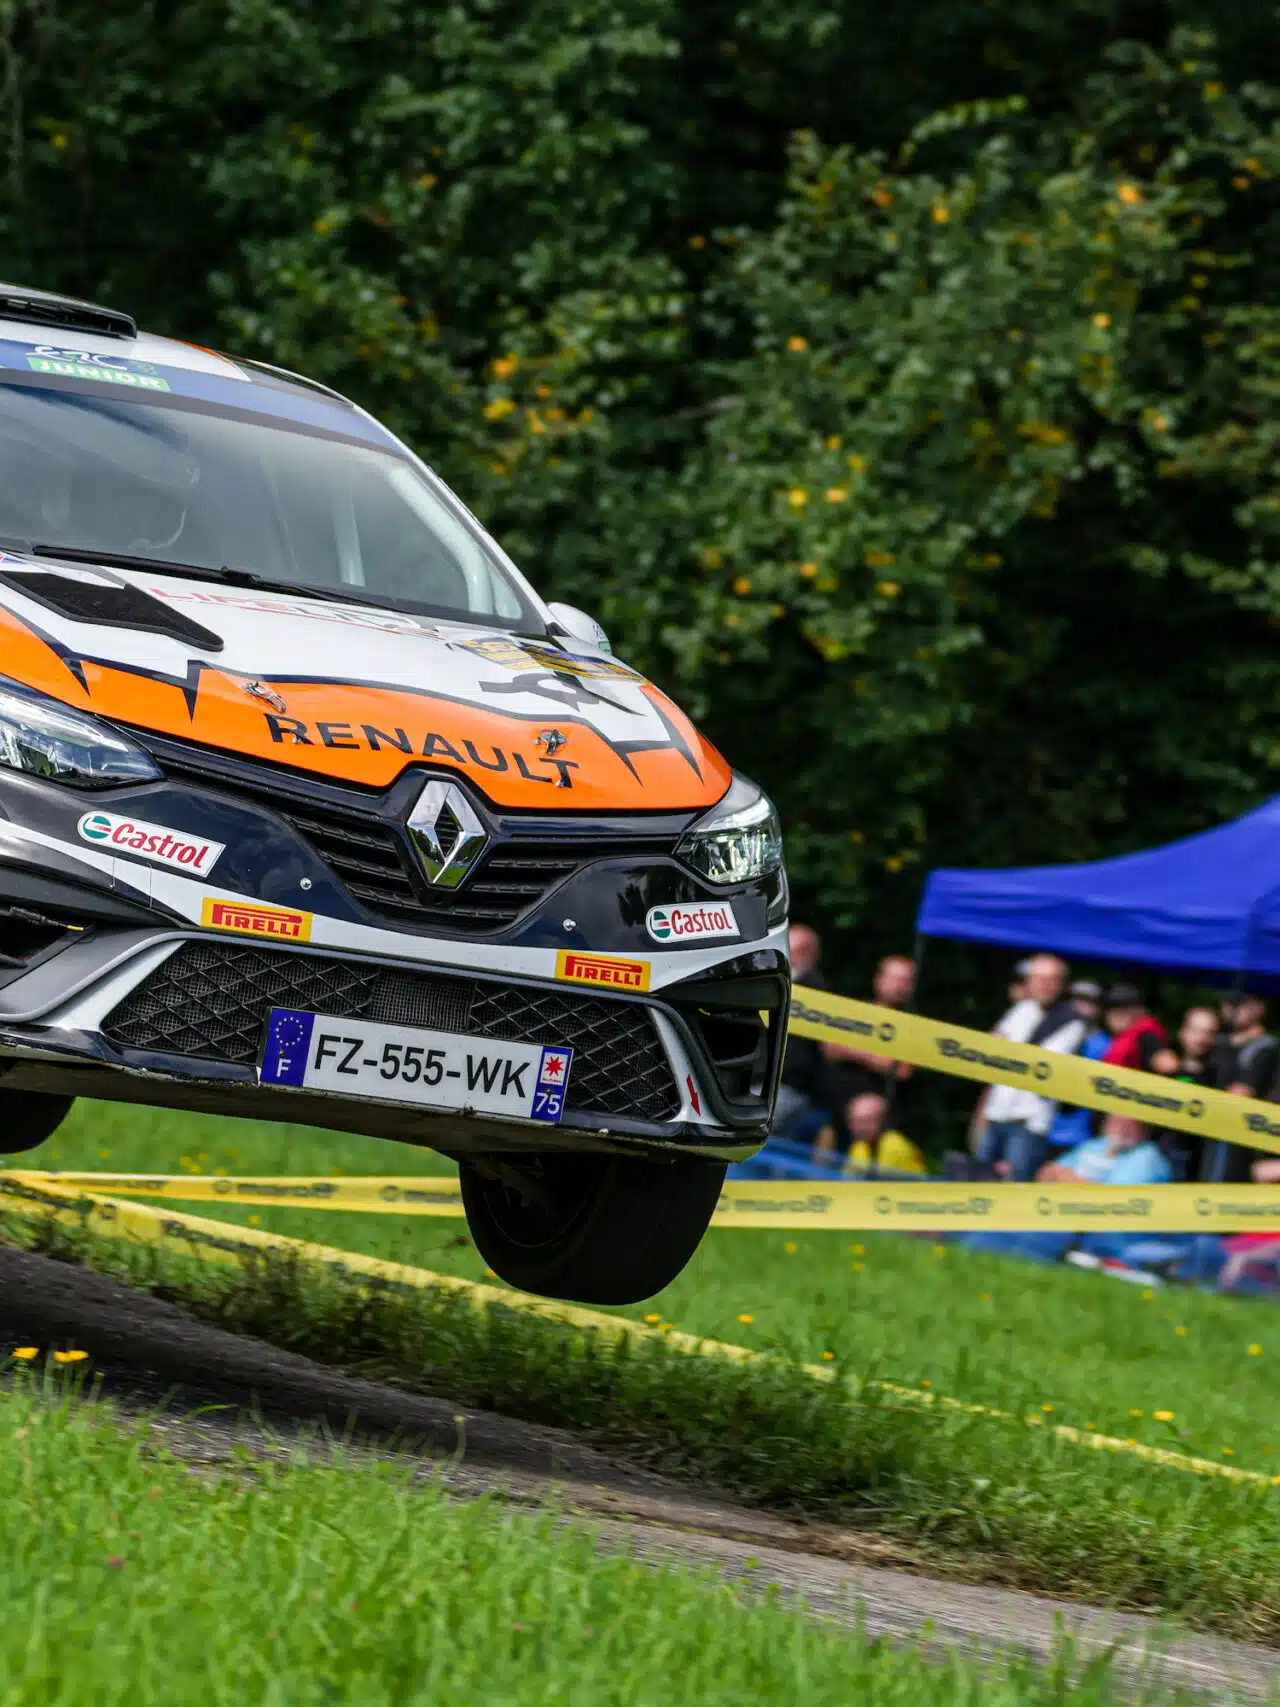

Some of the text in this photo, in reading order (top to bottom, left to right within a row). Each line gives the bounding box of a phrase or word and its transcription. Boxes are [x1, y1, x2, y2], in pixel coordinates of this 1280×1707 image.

[40, 361, 161, 389] JUNIOR
[264, 713, 580, 788] RENAULT
[111, 823, 210, 868] Castrol
[212, 903, 303, 937] PIRELLI
[671, 907, 733, 935] Castrol
[564, 955, 644, 986] PIRELLI
[276, 1058, 292, 1078] F
[314, 1033, 531, 1099] FZ-555-WK
[535, 1091, 561, 1115] 75
